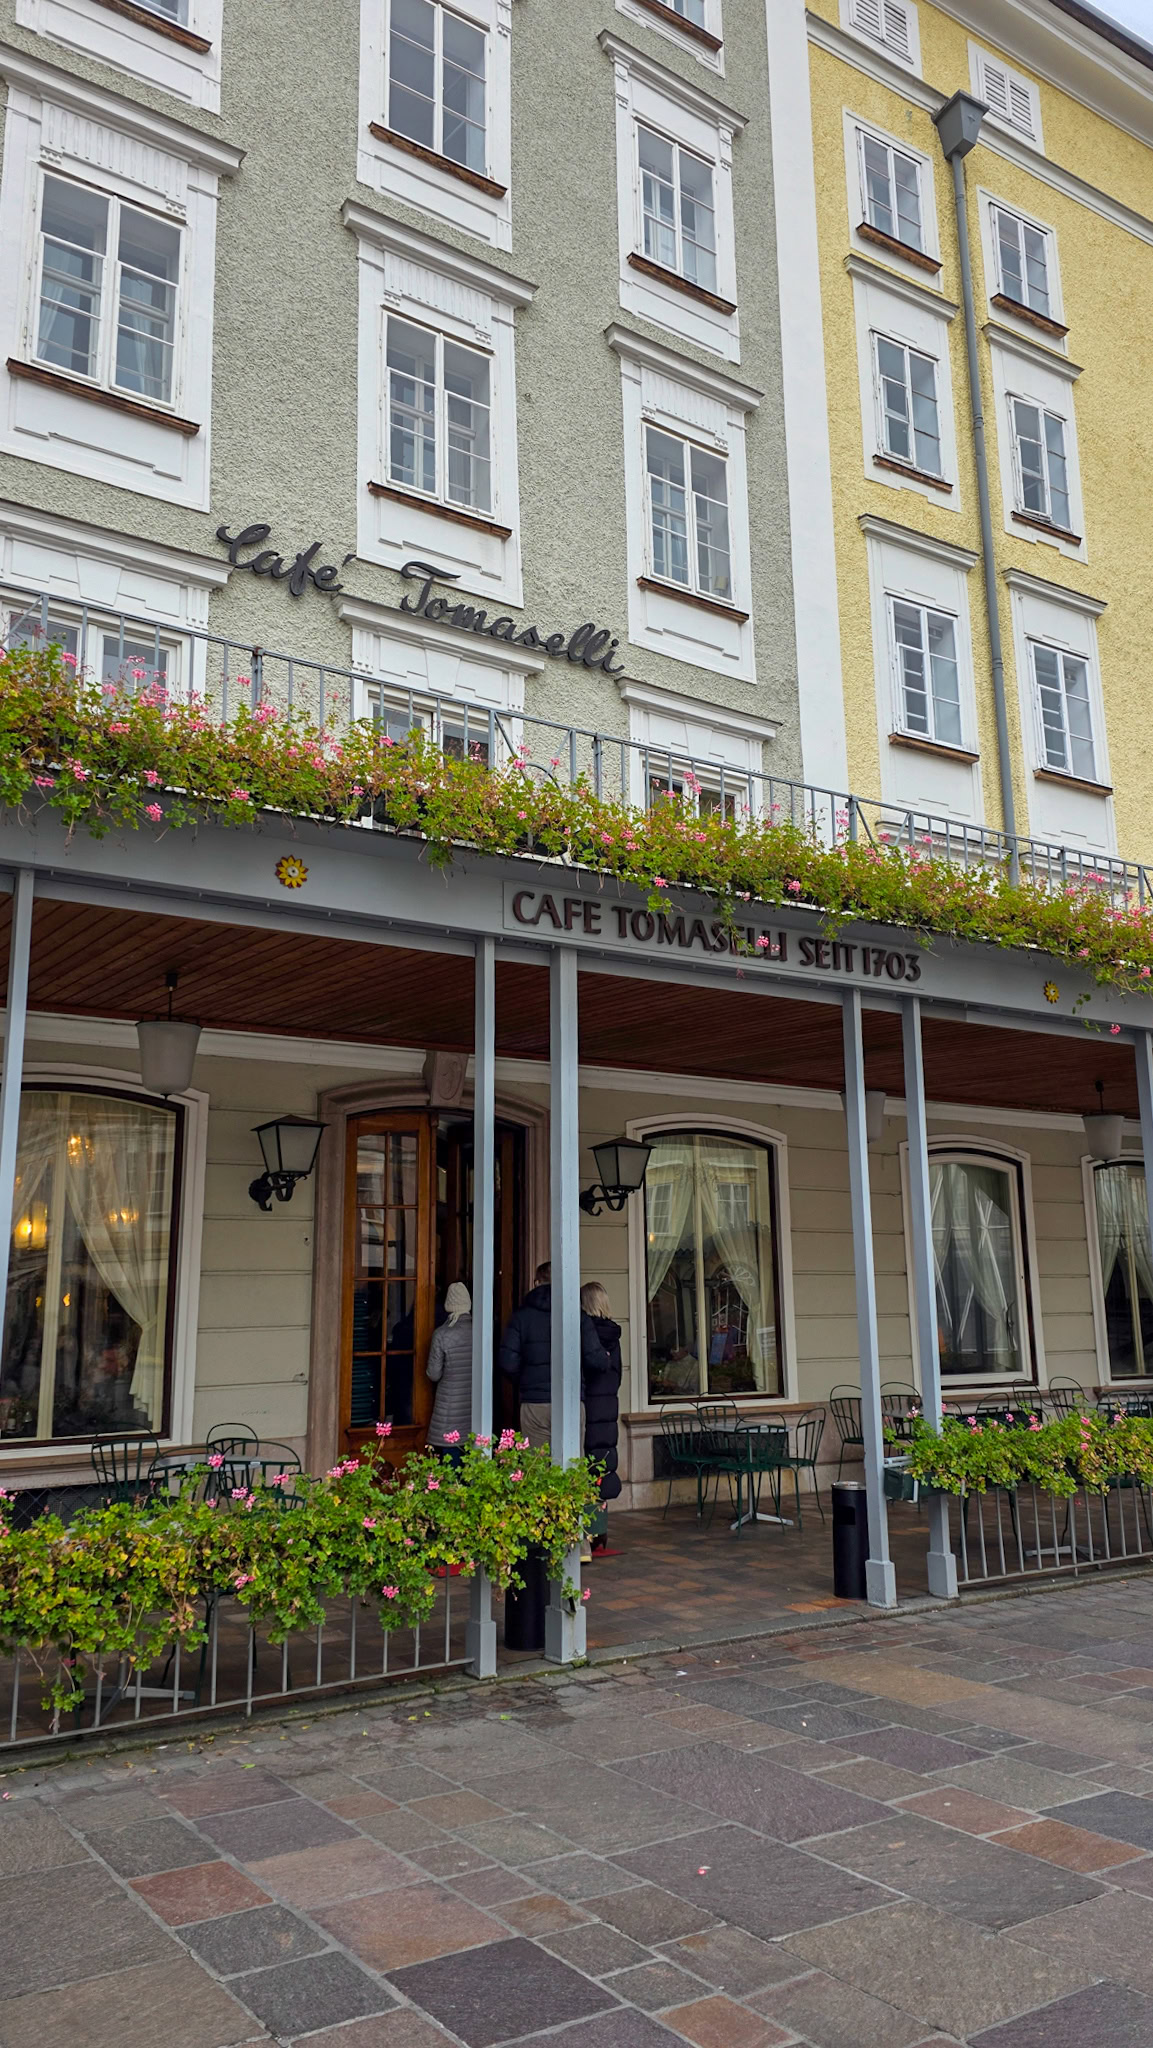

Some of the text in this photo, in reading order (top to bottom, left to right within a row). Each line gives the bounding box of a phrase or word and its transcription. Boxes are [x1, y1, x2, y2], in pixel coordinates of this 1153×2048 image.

[216, 523, 625, 673] Café Tomaselli
[512, 890, 921, 981] CAFE TOMASELLI SEIT 1703
